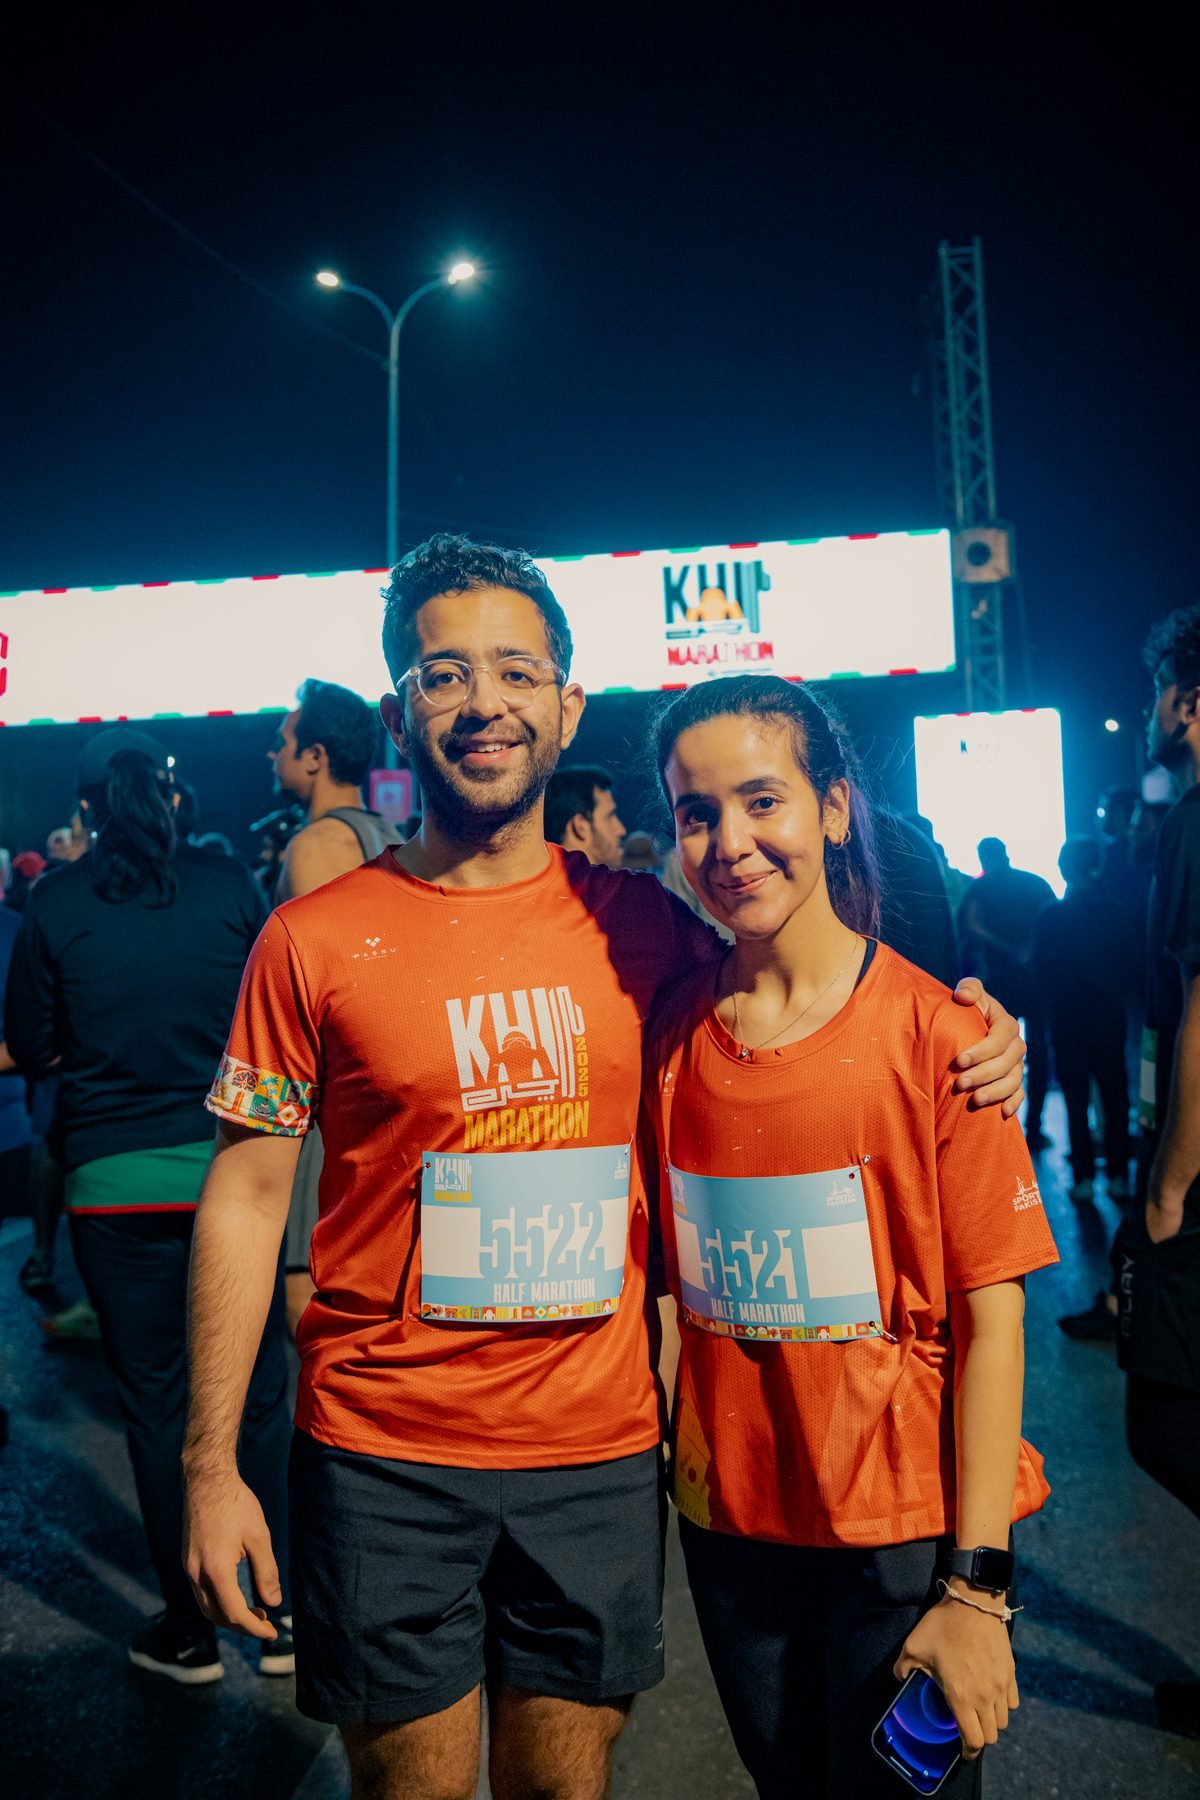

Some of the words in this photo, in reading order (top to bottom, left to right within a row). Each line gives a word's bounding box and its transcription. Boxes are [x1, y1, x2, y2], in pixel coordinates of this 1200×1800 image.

[668, 641, 774, 665] MARATHON
[575, 1036, 589, 1097] 2025
[463, 1100, 590, 1149] MARATHON
[479, 1200, 606, 1279] 5522
[698, 1226, 811, 1300] 5521
[493, 1283, 526, 1303] HALF
[531, 1278, 595, 1303] MARATHON
[711, 1297, 735, 1320] HALF
[739, 1301, 806, 1323] MARATHON
